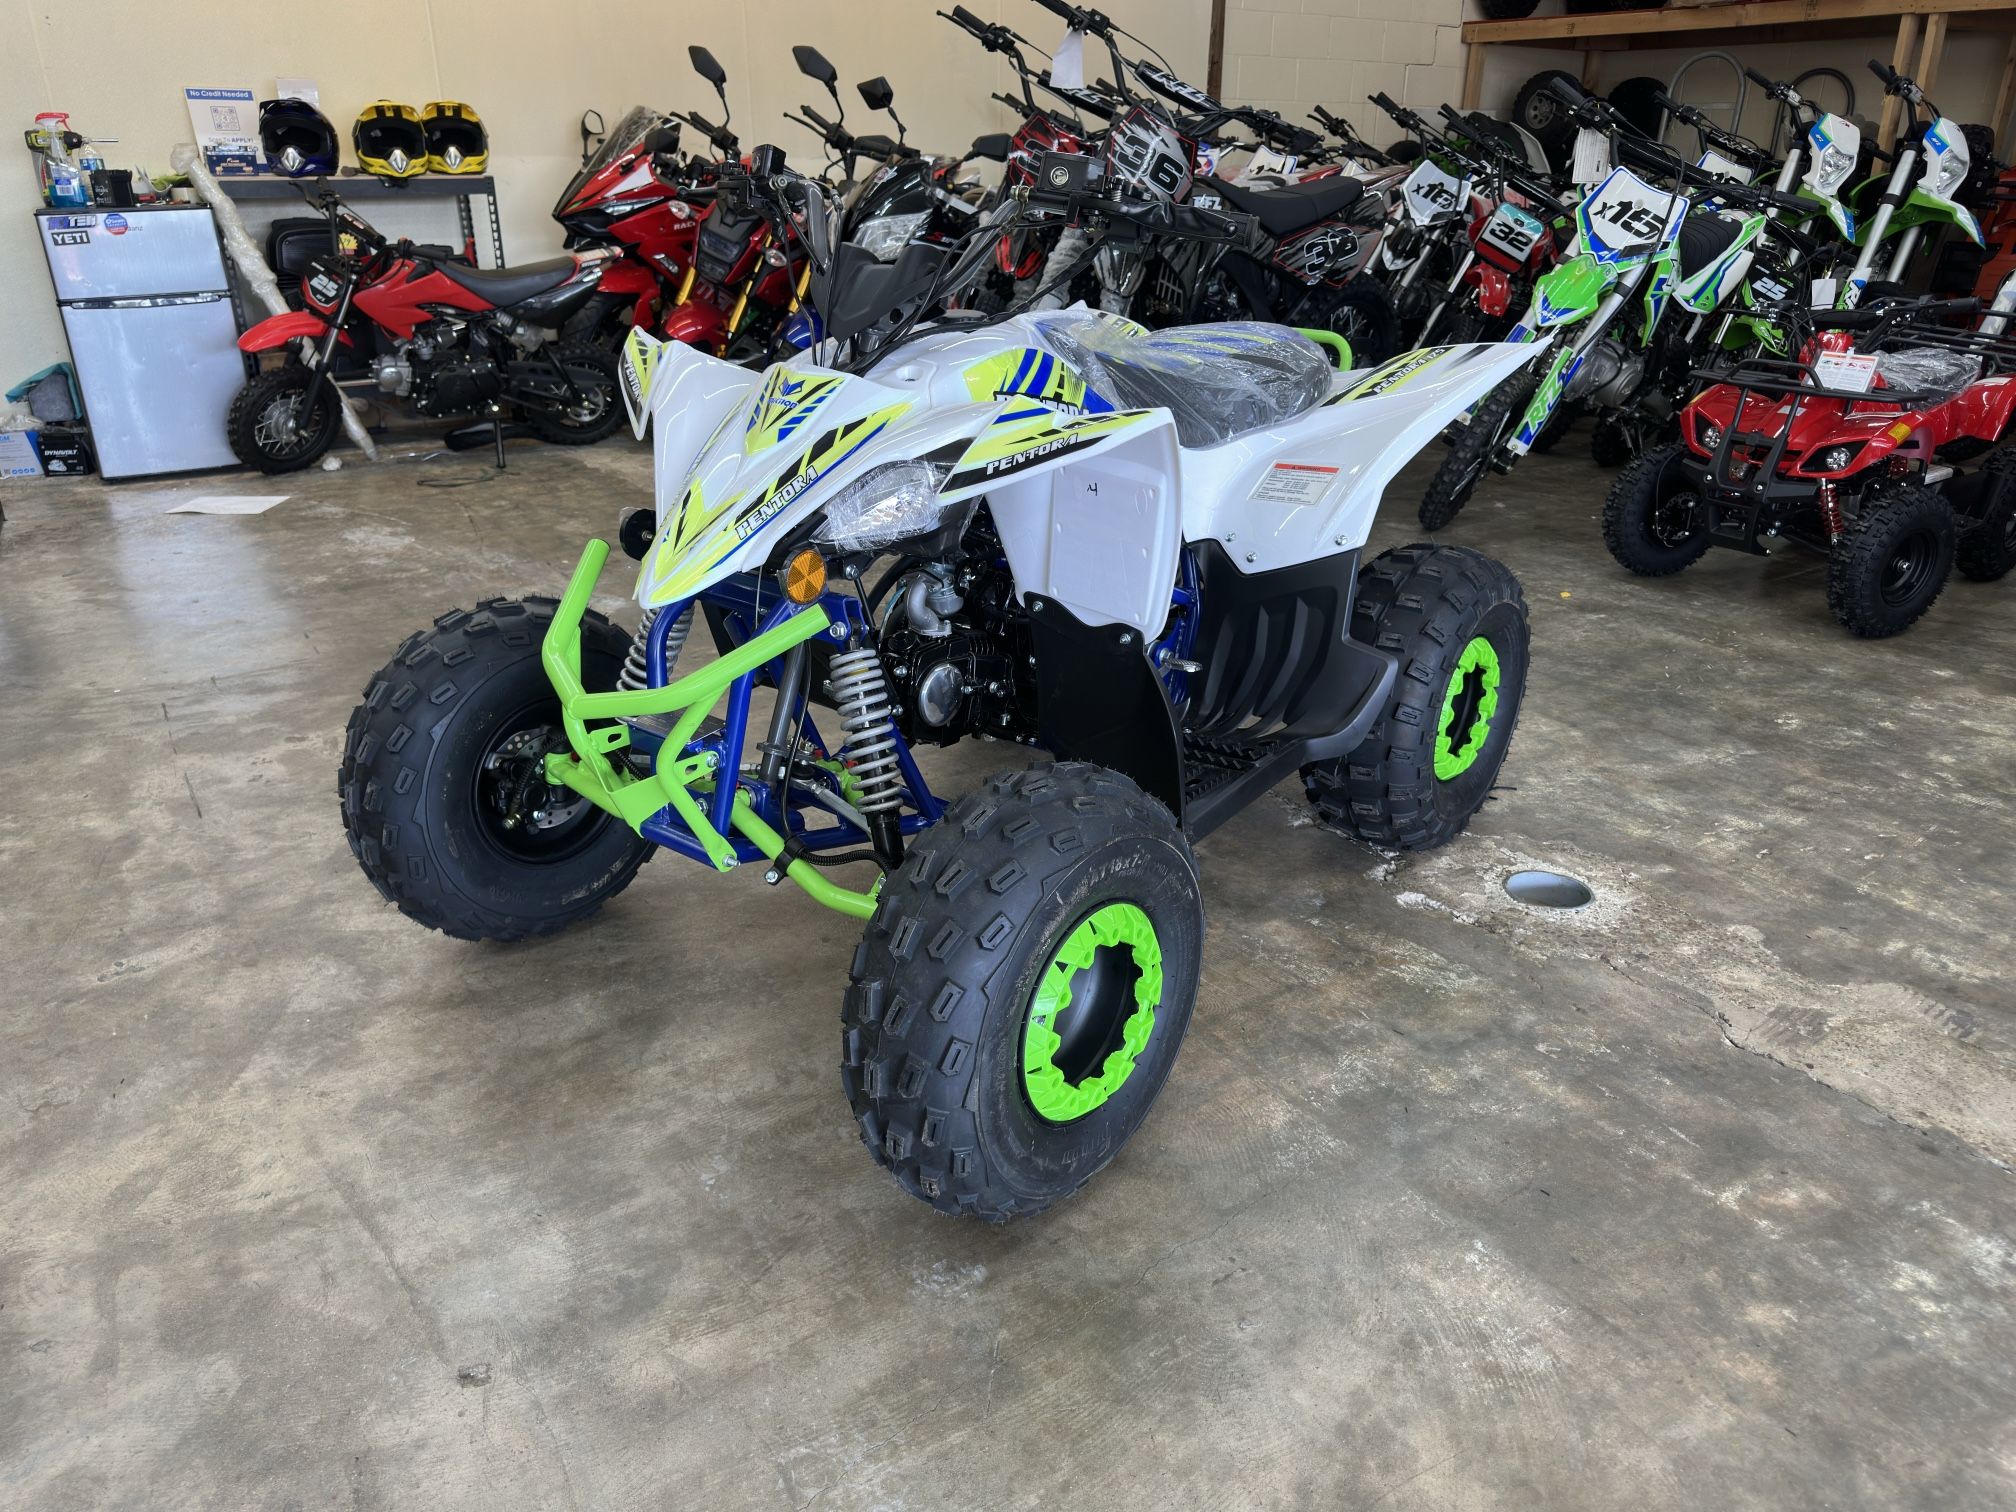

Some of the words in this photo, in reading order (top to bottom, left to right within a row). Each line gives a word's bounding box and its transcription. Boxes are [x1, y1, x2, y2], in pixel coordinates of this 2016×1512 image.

[1116, 133, 1185, 195] 36
[53, 233, 88, 245] YETI
[1489, 220, 1533, 252] 32
[1593, 200, 1667, 241] x15
[310, 274, 338, 297] 25
[1752, 277, 1788, 300] 25
[1373, 358, 1429, 394] PENTORA
[1527, 368, 1563, 436] RFZ
[986, 433, 1079, 475] PENTORA
[735, 465, 819, 540] PENTORA
